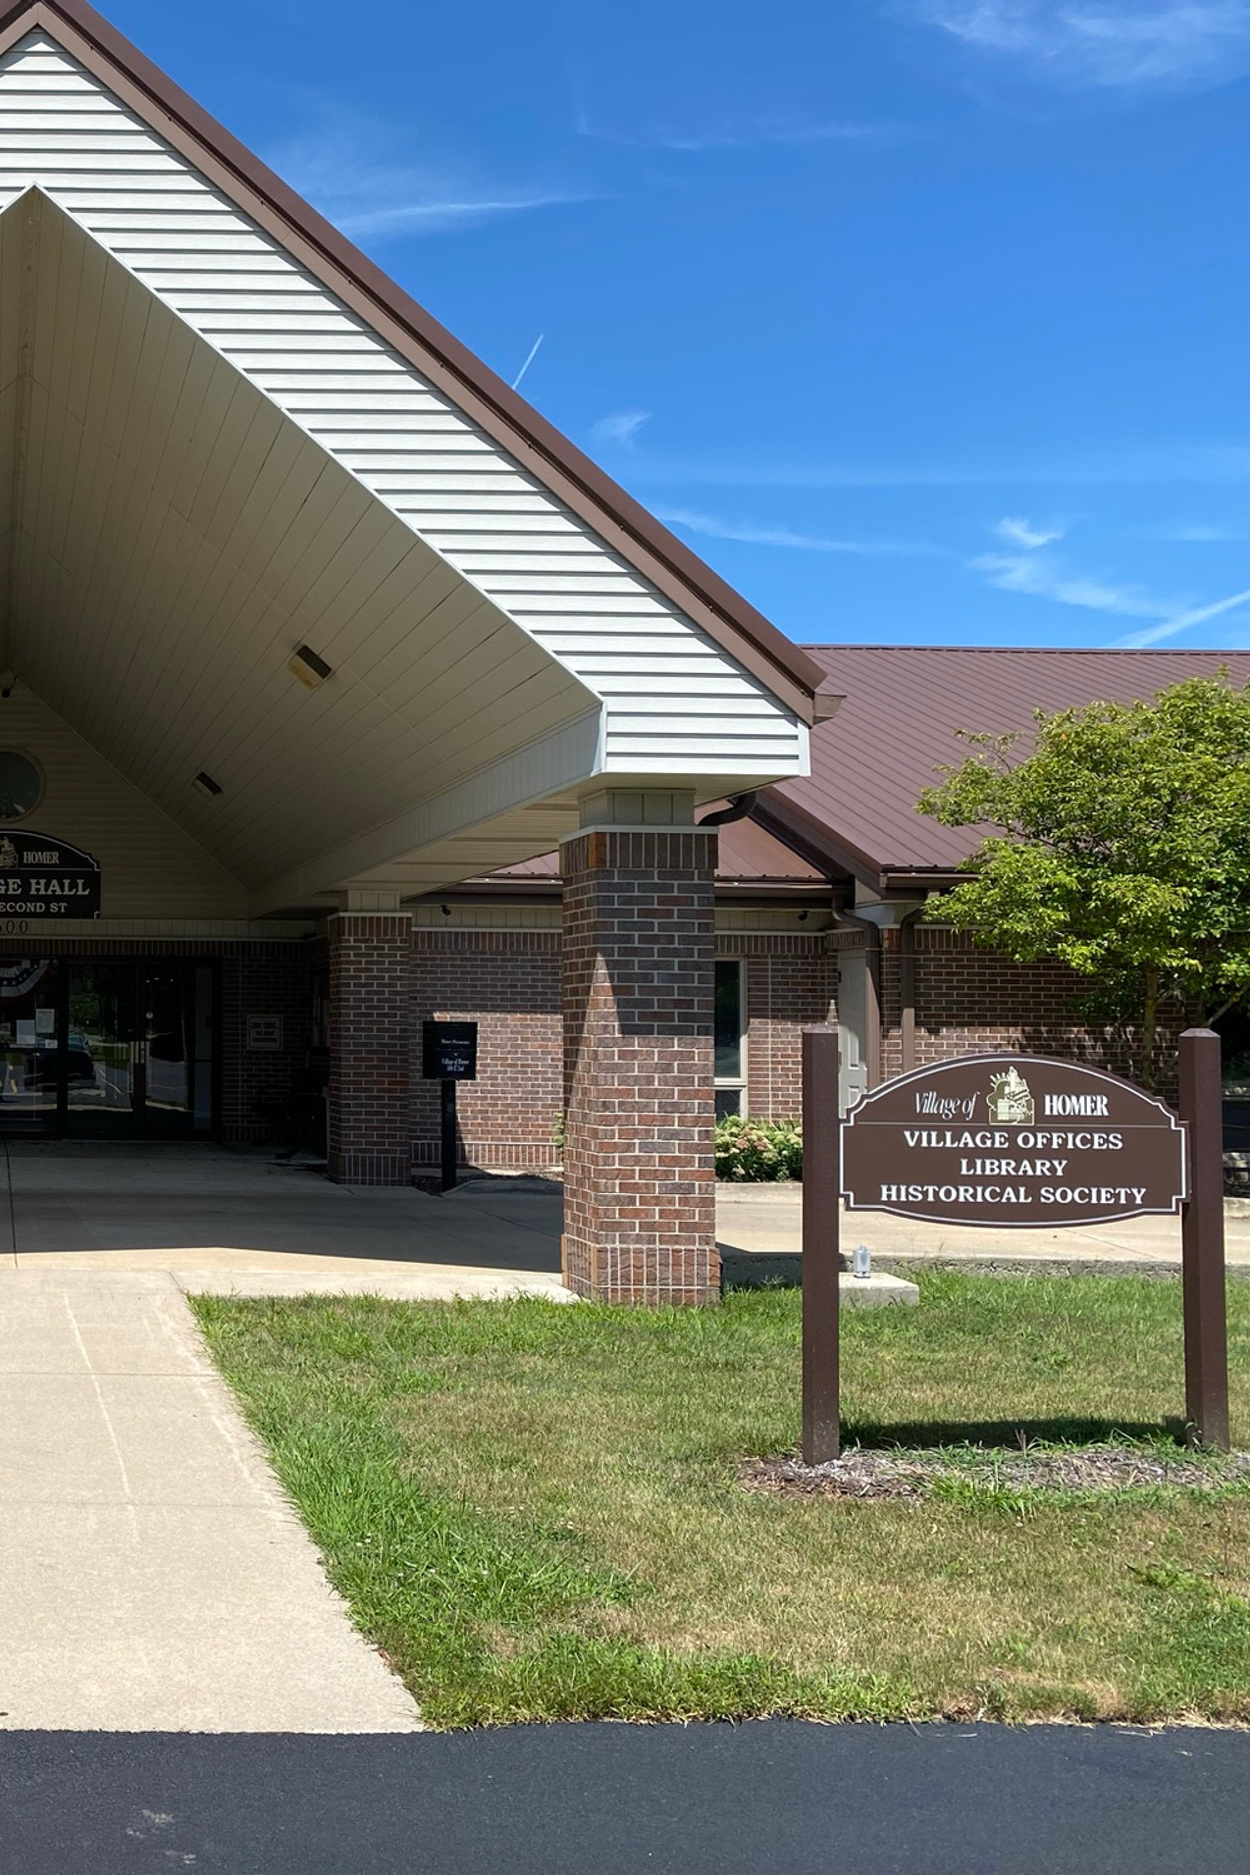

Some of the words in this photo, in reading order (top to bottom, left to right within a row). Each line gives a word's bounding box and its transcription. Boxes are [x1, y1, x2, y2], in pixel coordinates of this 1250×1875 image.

[23, 851, 59, 864] HOMER
[30, 879, 90, 895] HALL
[50, 902, 68, 913] ST
[914, 1092, 960, 1119] Village
[961, 1091, 979, 1120] of
[1044, 1094, 1109, 1117] HOMER
[903, 1130, 1009, 1149] VILLAGE
[1016, 1131, 1124, 1150] OFFICES
[960, 1159, 1068, 1176] LIBRARY
[880, 1184, 1032, 1203] HISTORICAL
[1040, 1186, 1147, 1205] SOCIETY
